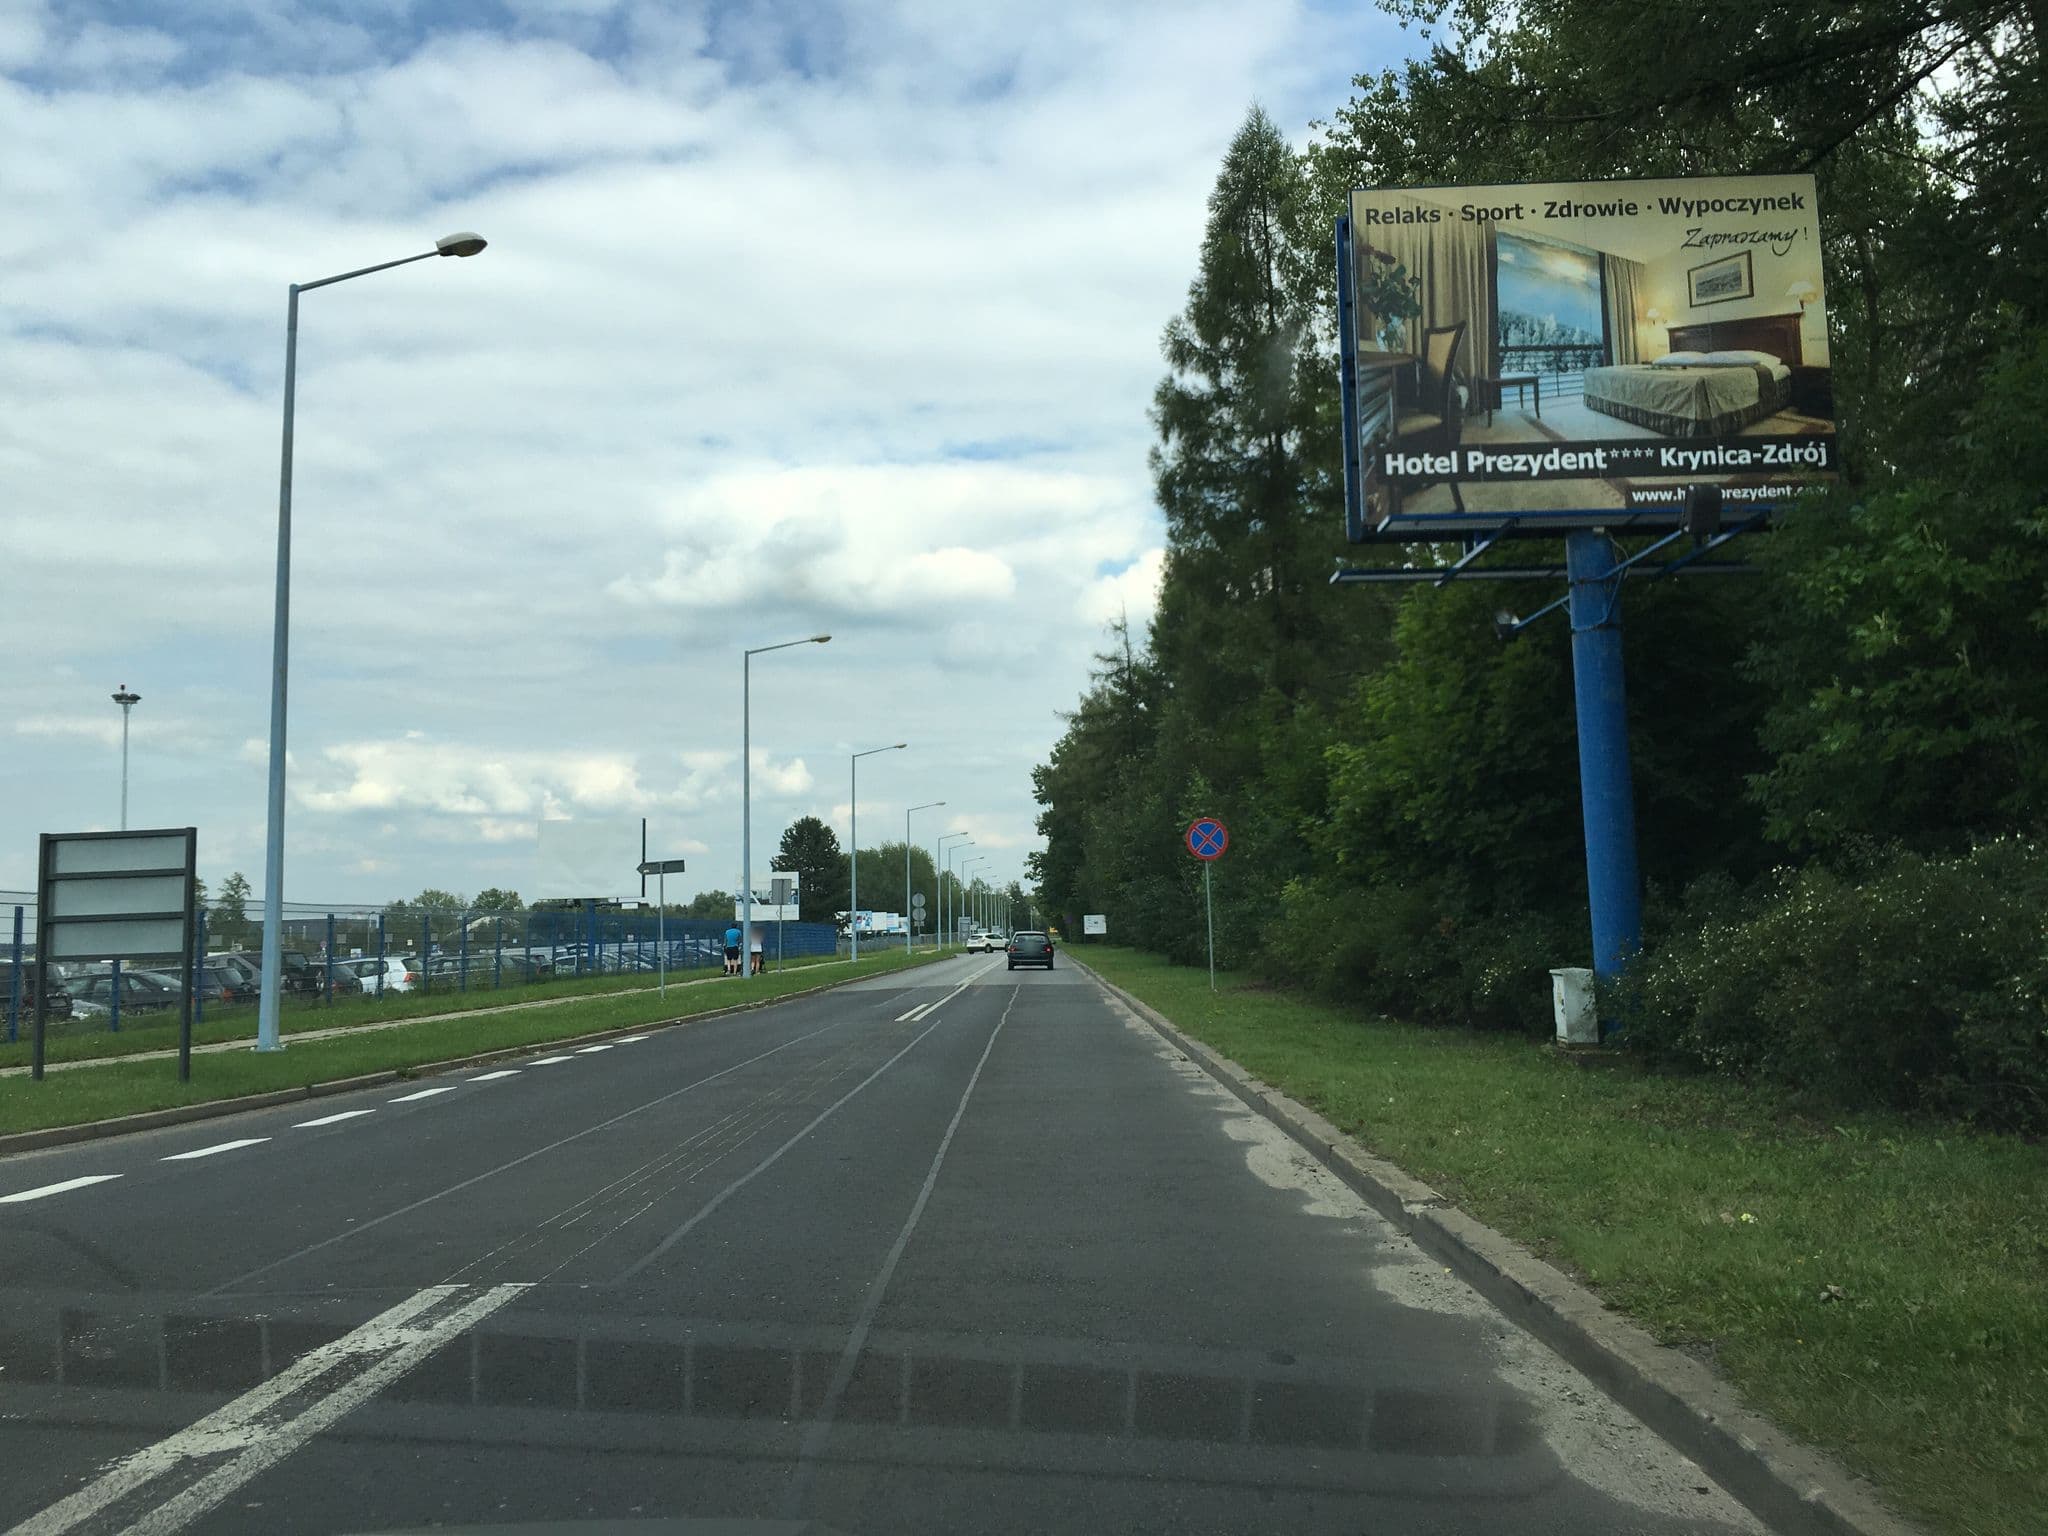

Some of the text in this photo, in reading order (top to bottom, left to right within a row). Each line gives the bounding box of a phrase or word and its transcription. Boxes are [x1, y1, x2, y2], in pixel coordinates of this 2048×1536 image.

[1365, 192, 1805, 225] Relaks Sport Zdrowie Wypoczynek
[1385, 441, 1828, 476] Hotel Prezydent Krynica-Zdrój
